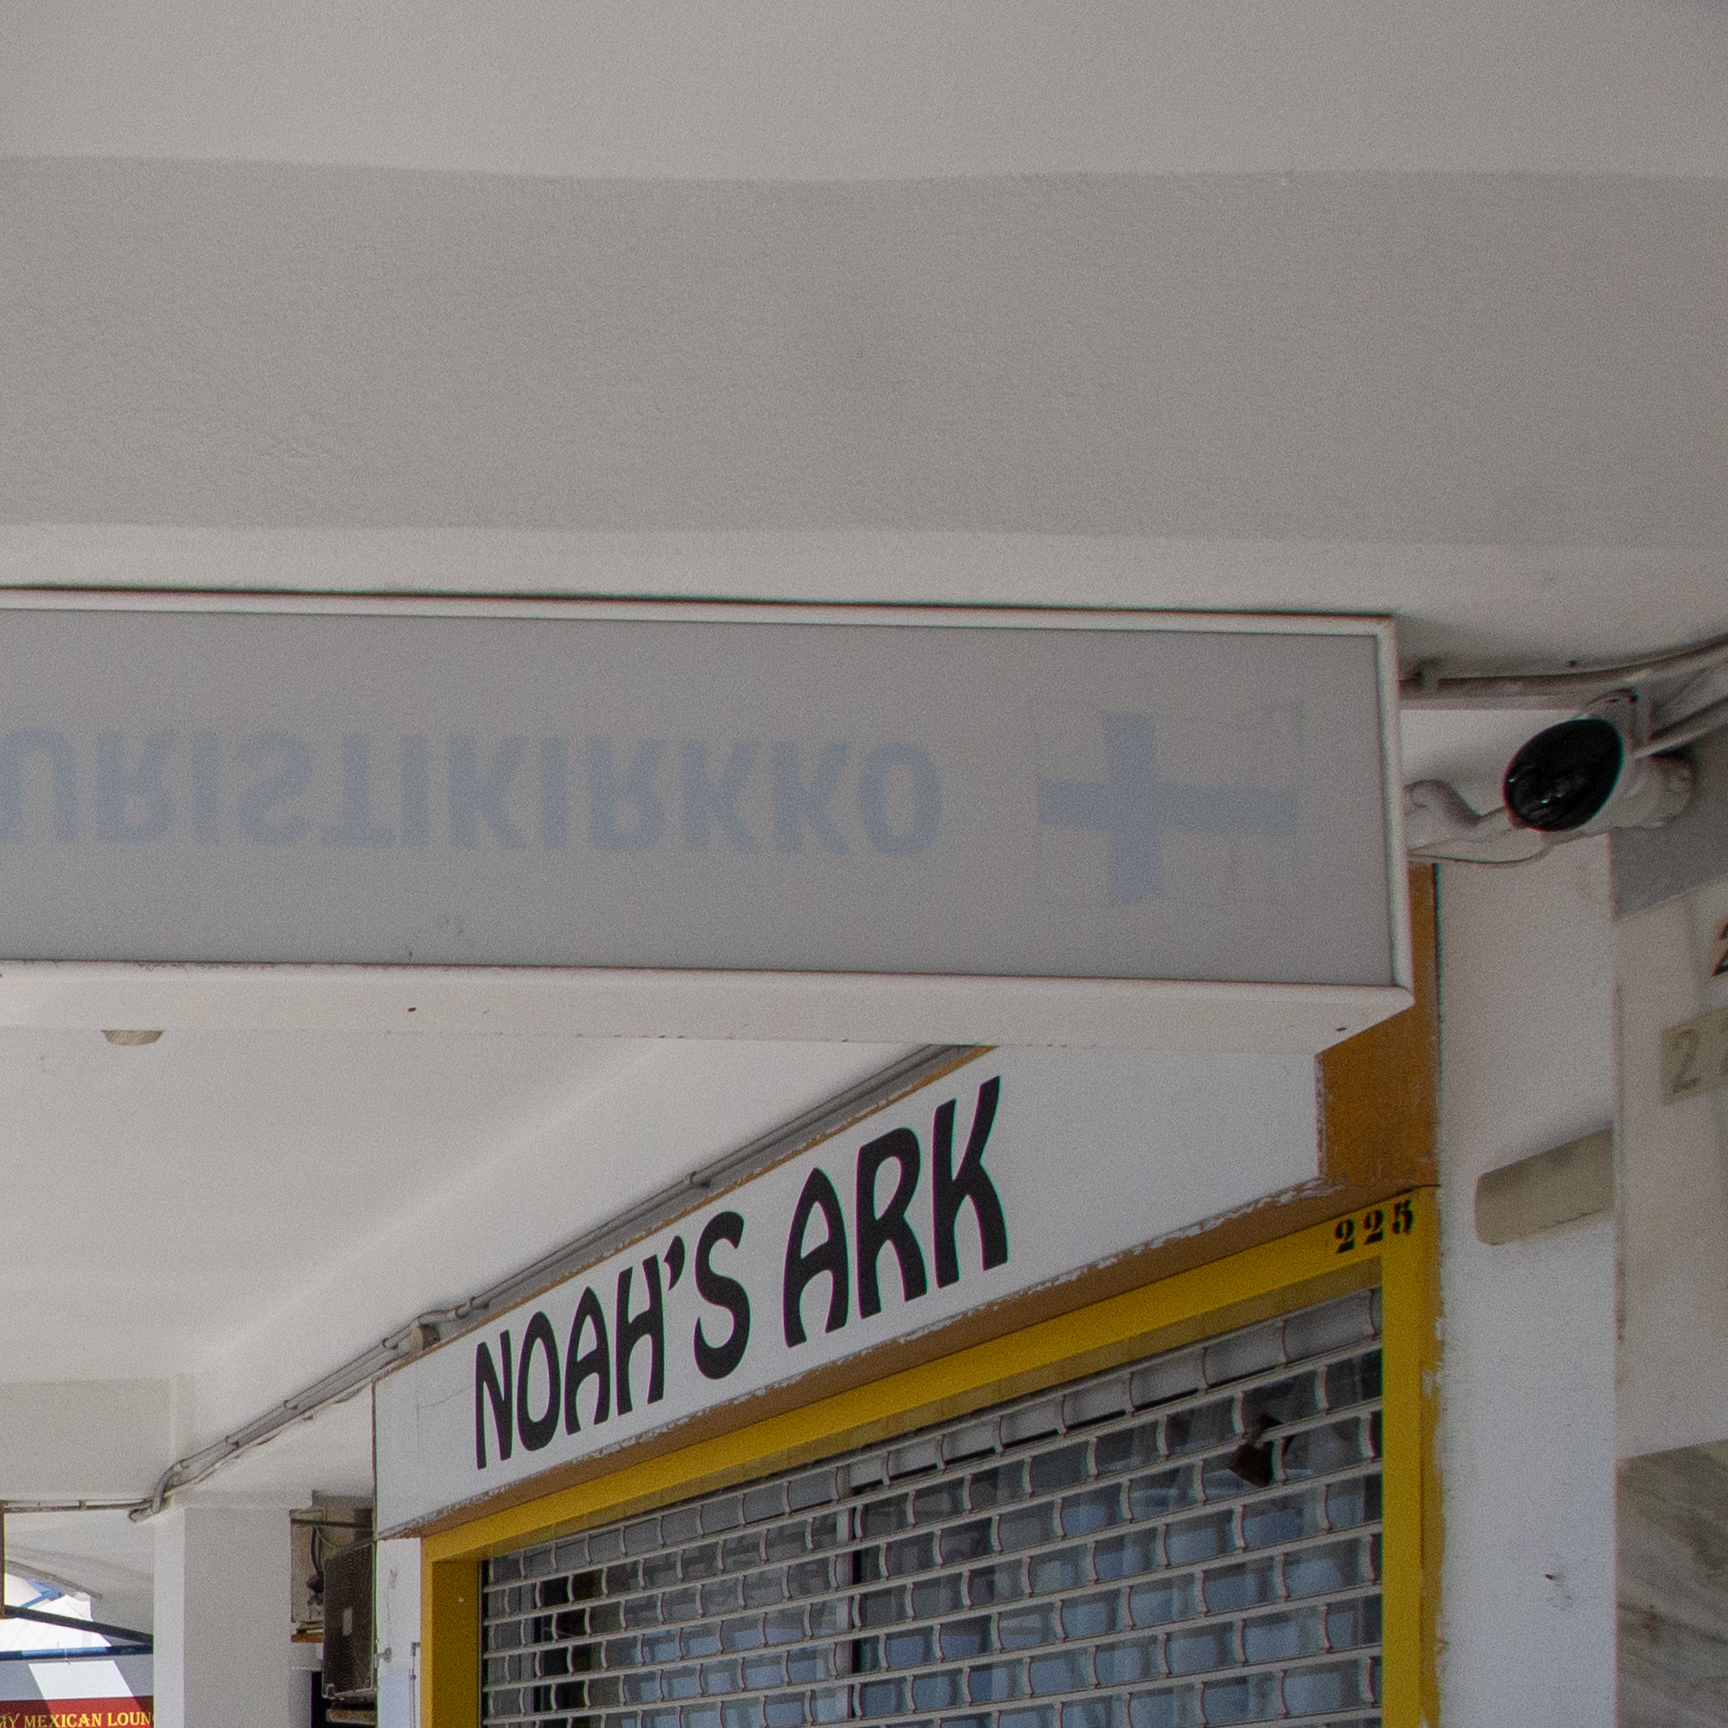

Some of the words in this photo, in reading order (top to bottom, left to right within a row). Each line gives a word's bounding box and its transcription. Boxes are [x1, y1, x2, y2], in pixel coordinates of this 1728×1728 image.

[1333, 1198, 1415, 1255] 225
[474, 1210, 751, 1470] NOAH'S
[782, 1074, 1009, 1349] ARK
[107, 1710, 154, 1727] LOUN
